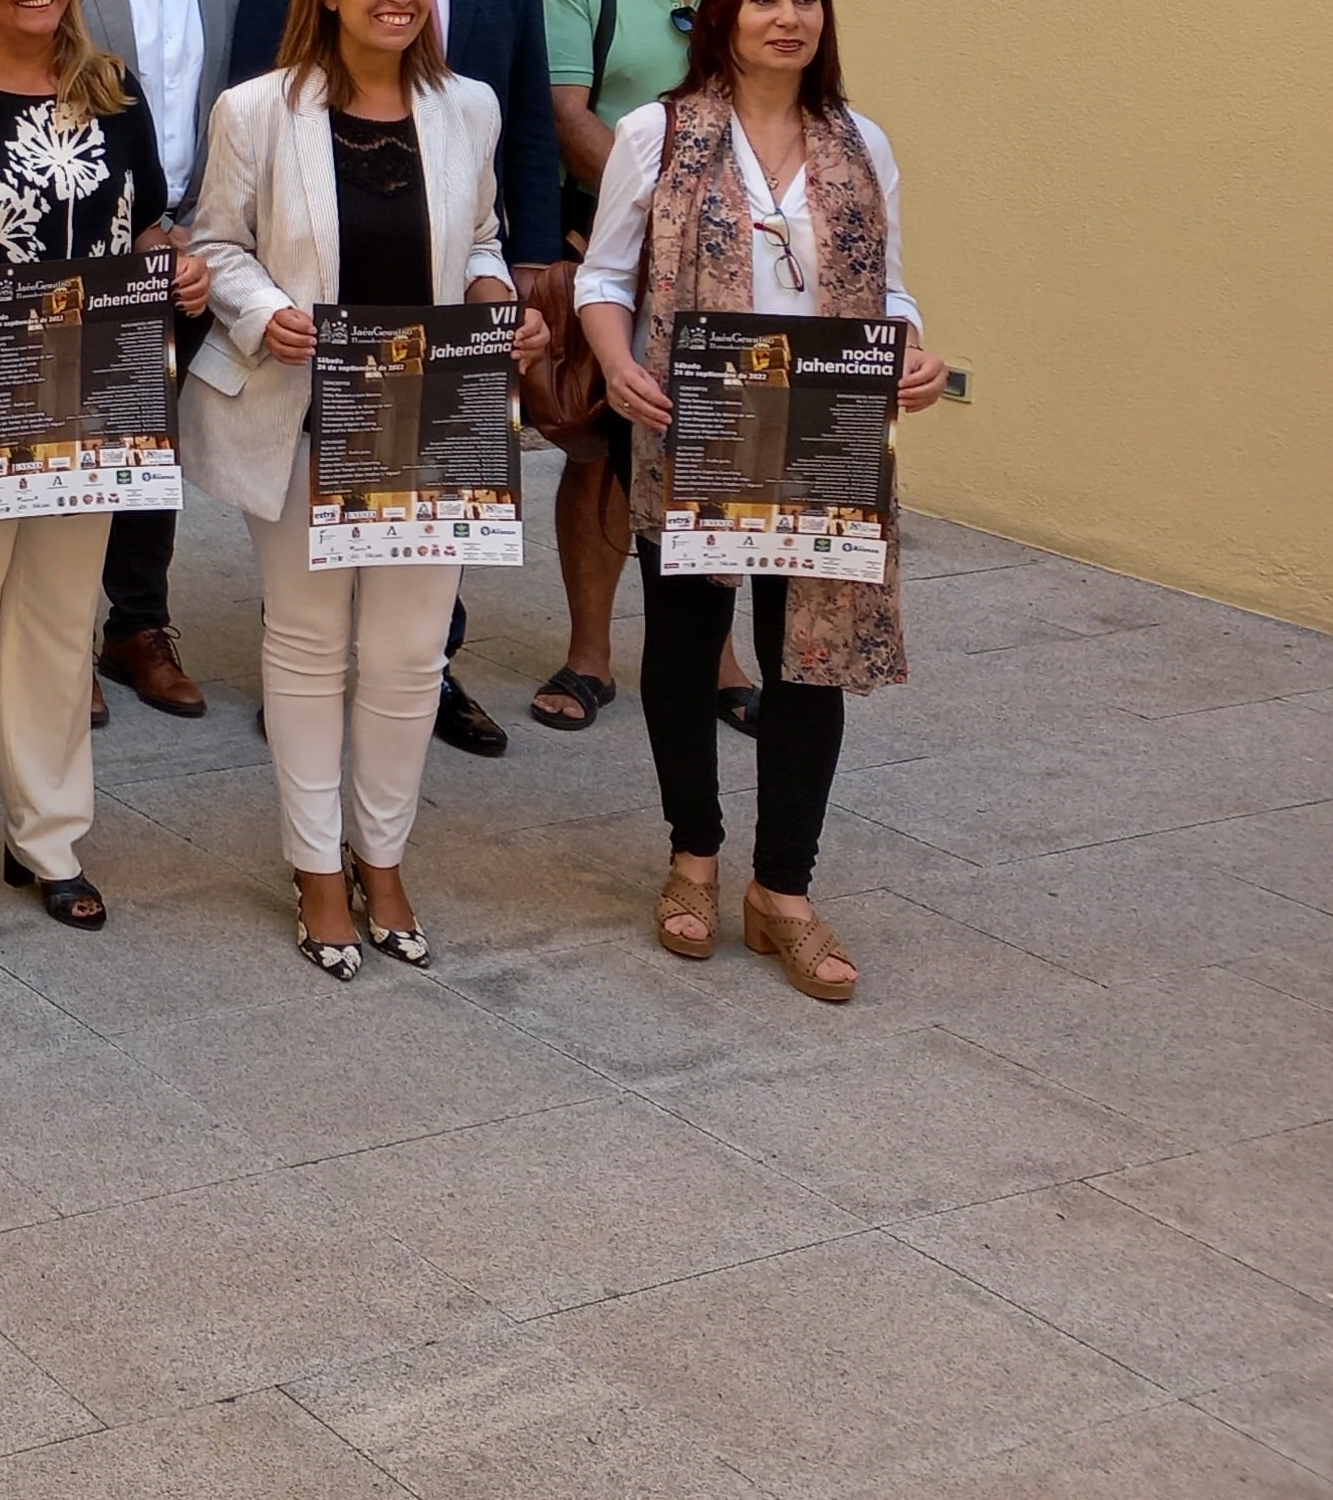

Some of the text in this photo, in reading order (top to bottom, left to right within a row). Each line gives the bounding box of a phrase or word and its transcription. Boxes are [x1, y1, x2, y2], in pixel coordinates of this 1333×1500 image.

[145, 254, 170, 274] VII
[126, 276, 169, 293] noche
[88, 290, 168, 311] jahenciana
[490, 306, 517, 325] VII
[470, 328, 514, 344] noche
[864, 324, 896, 345] VII
[429, 341, 512, 361] jahenciana
[842, 347, 895, 363] noche
[796, 357, 894, 377] jahenciana
